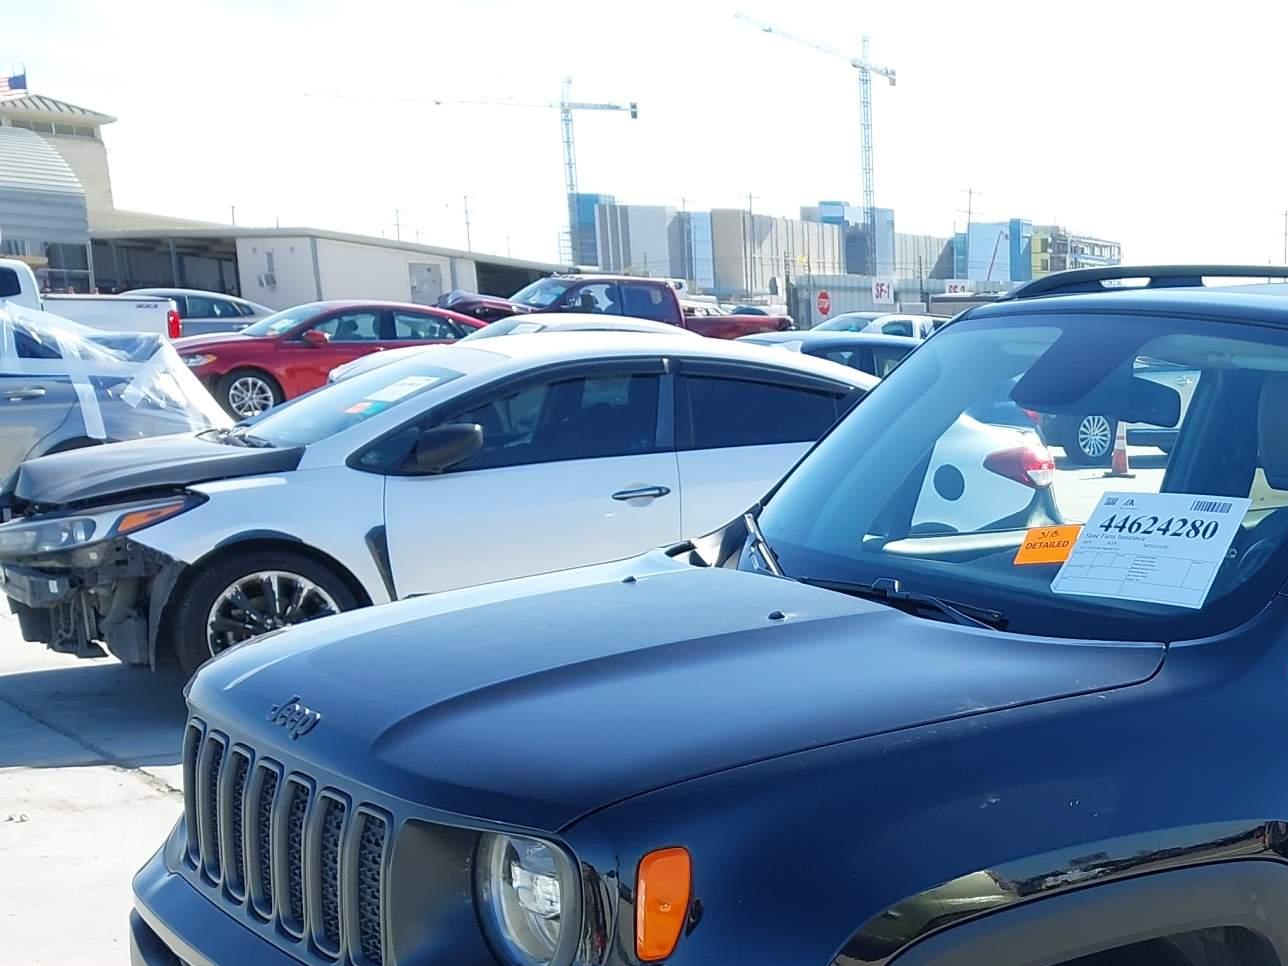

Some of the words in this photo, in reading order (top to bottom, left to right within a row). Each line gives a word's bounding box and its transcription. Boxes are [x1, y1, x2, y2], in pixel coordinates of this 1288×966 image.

[875, 282, 890, 299] SF-1
[1099, 513, 1220, 541] 44624280
[1025, 540, 1070, 550] DETAILED
[265, 693, 321, 740] Jeep
